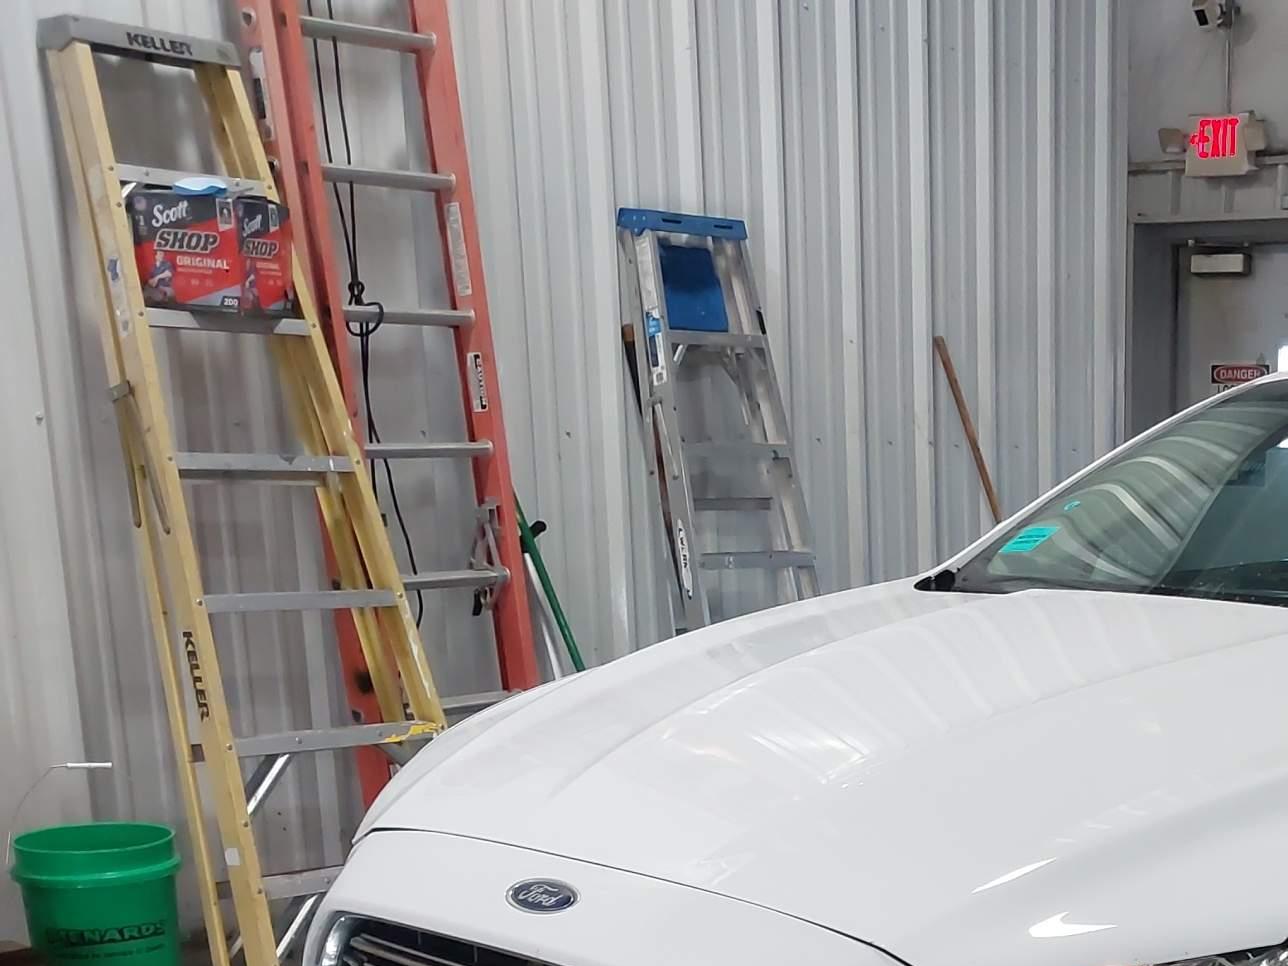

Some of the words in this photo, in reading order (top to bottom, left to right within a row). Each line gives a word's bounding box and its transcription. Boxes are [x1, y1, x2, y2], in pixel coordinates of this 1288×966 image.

[126, 31, 193, 56] KELLER
[1199, 118, 1239, 158] EXIT
[151, 200, 189, 227] Scott
[155, 229, 219, 252] SHOP
[244, 239, 279, 258] SHOP
[176, 255, 230, 270] ORIGINAL
[182, 631, 210, 723] KELLER
[517, 883, 564, 907] Ford
